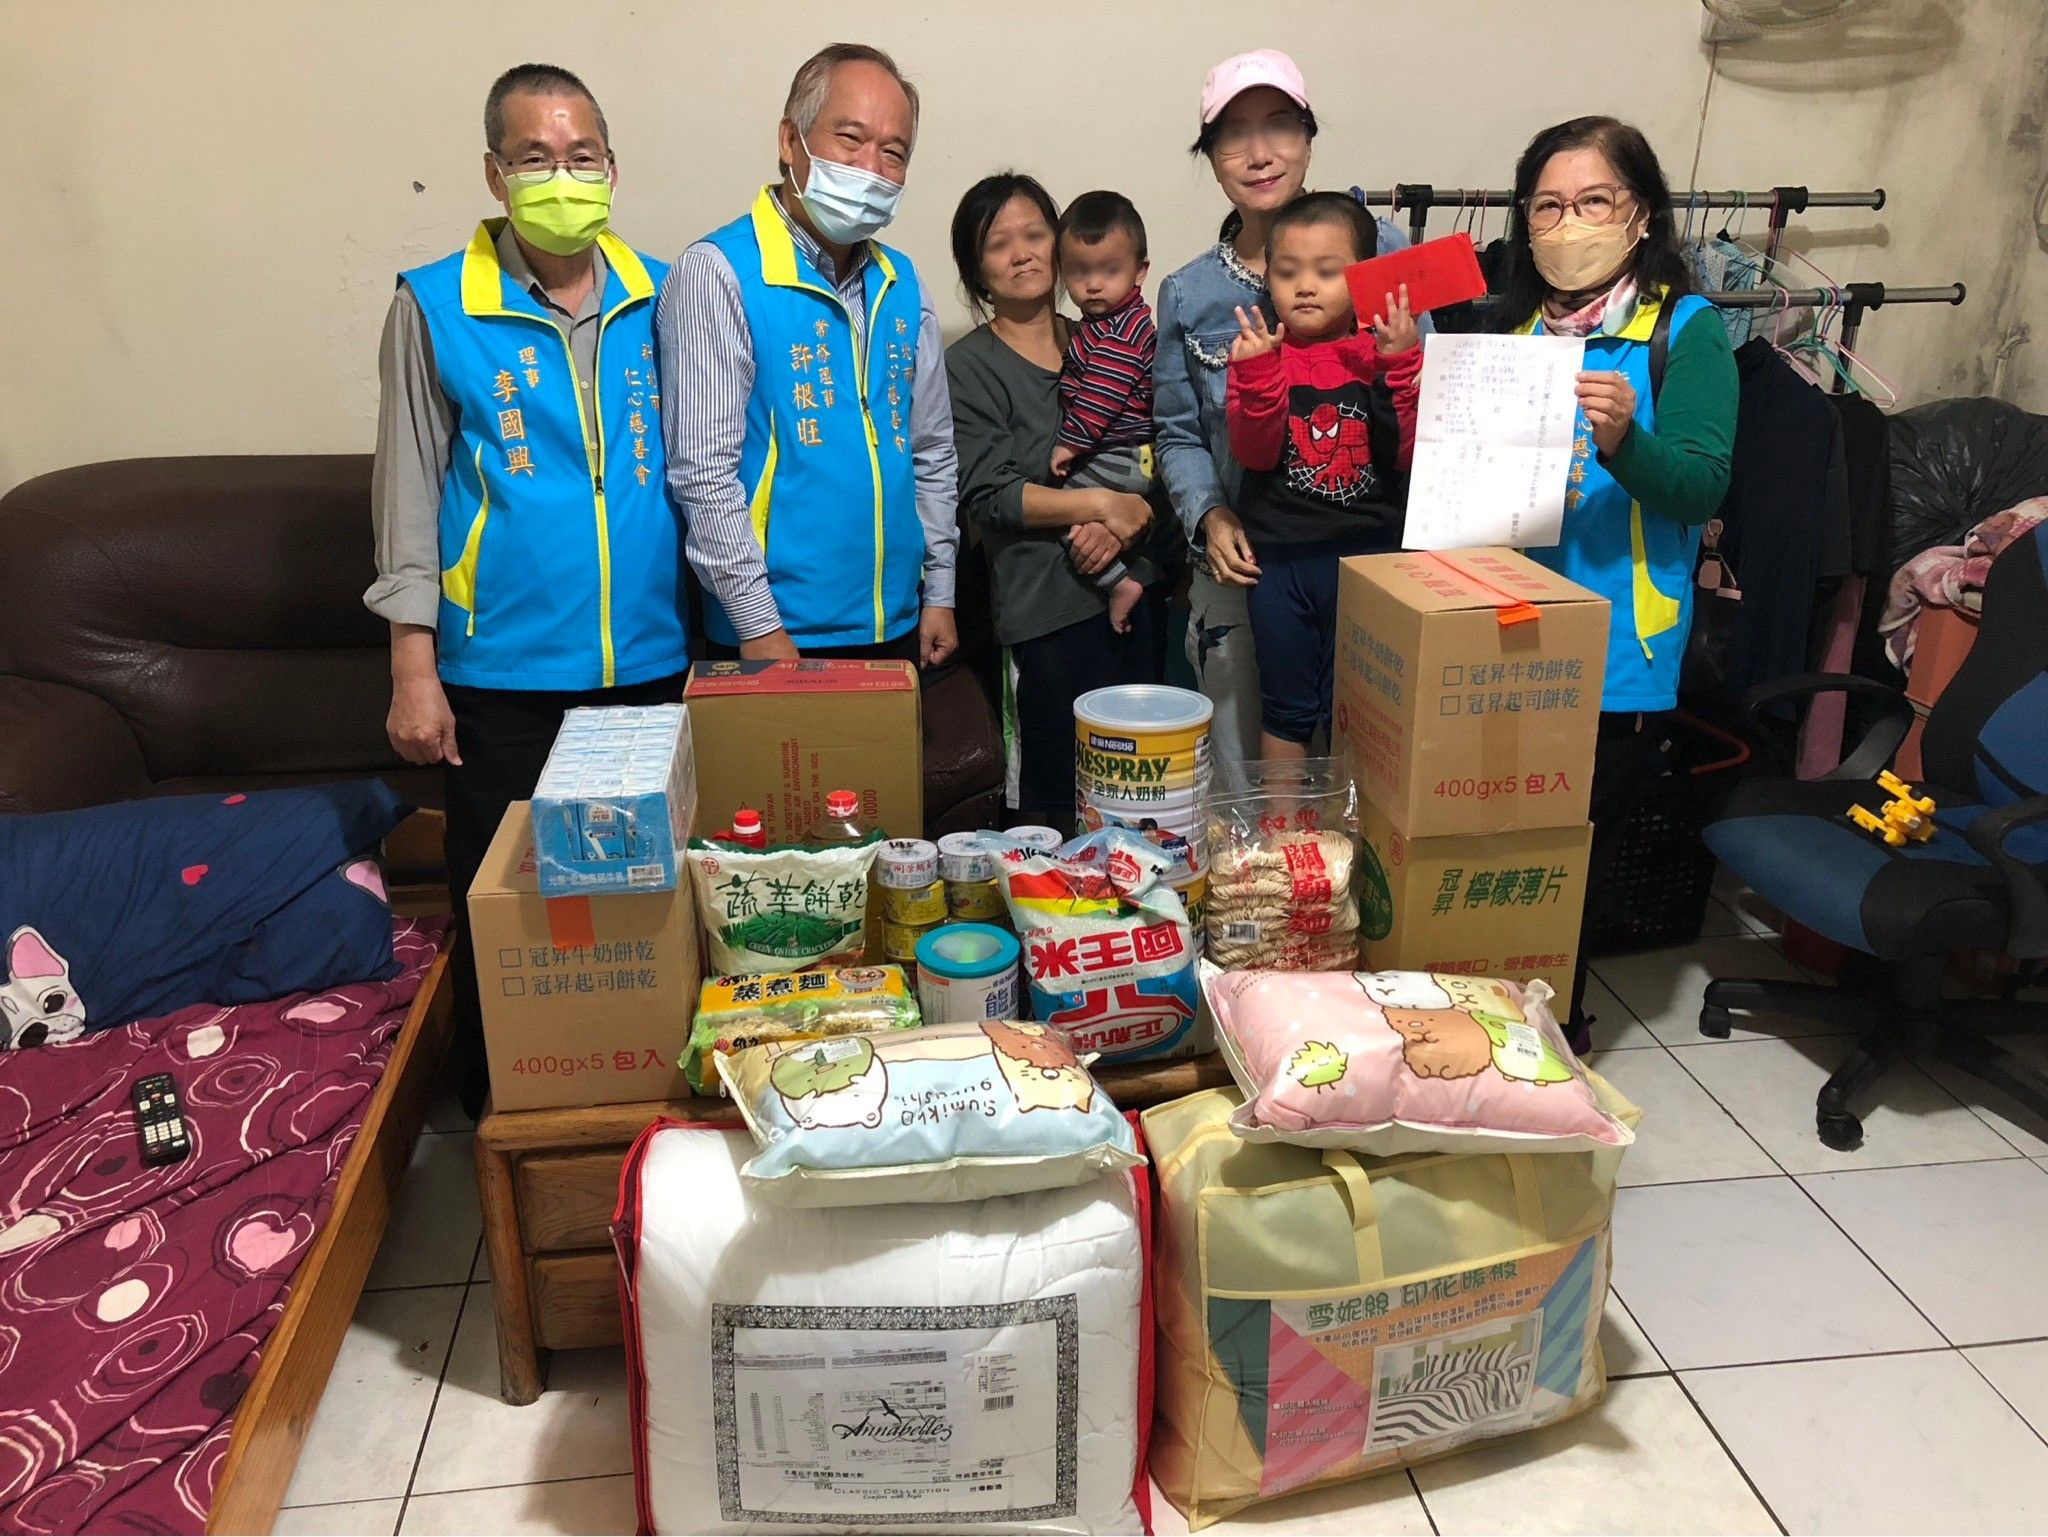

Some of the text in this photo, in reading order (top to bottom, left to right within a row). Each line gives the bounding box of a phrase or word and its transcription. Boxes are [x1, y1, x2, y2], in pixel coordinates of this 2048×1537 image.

[518, 345, 540, 389] 理事
[789, 342, 824, 448] 許根旺
[492, 369, 536, 478] 李國興
[1469, 658, 1584, 686] 冠昇牛奶餅乾
[1466, 687, 1580, 716] 冠昇起司餅乾
[1093, 780, 1166, 802] 全家人奶粉
[1463, 864, 1568, 910] 檸檬薄片
[531, 967, 658, 996] 冠昇起司餅乾
[732, 972, 829, 1003] 蒸煮麵
[612, 1049, 666, 1073] 包入
[831, 1415, 952, 1442] Annabelle
